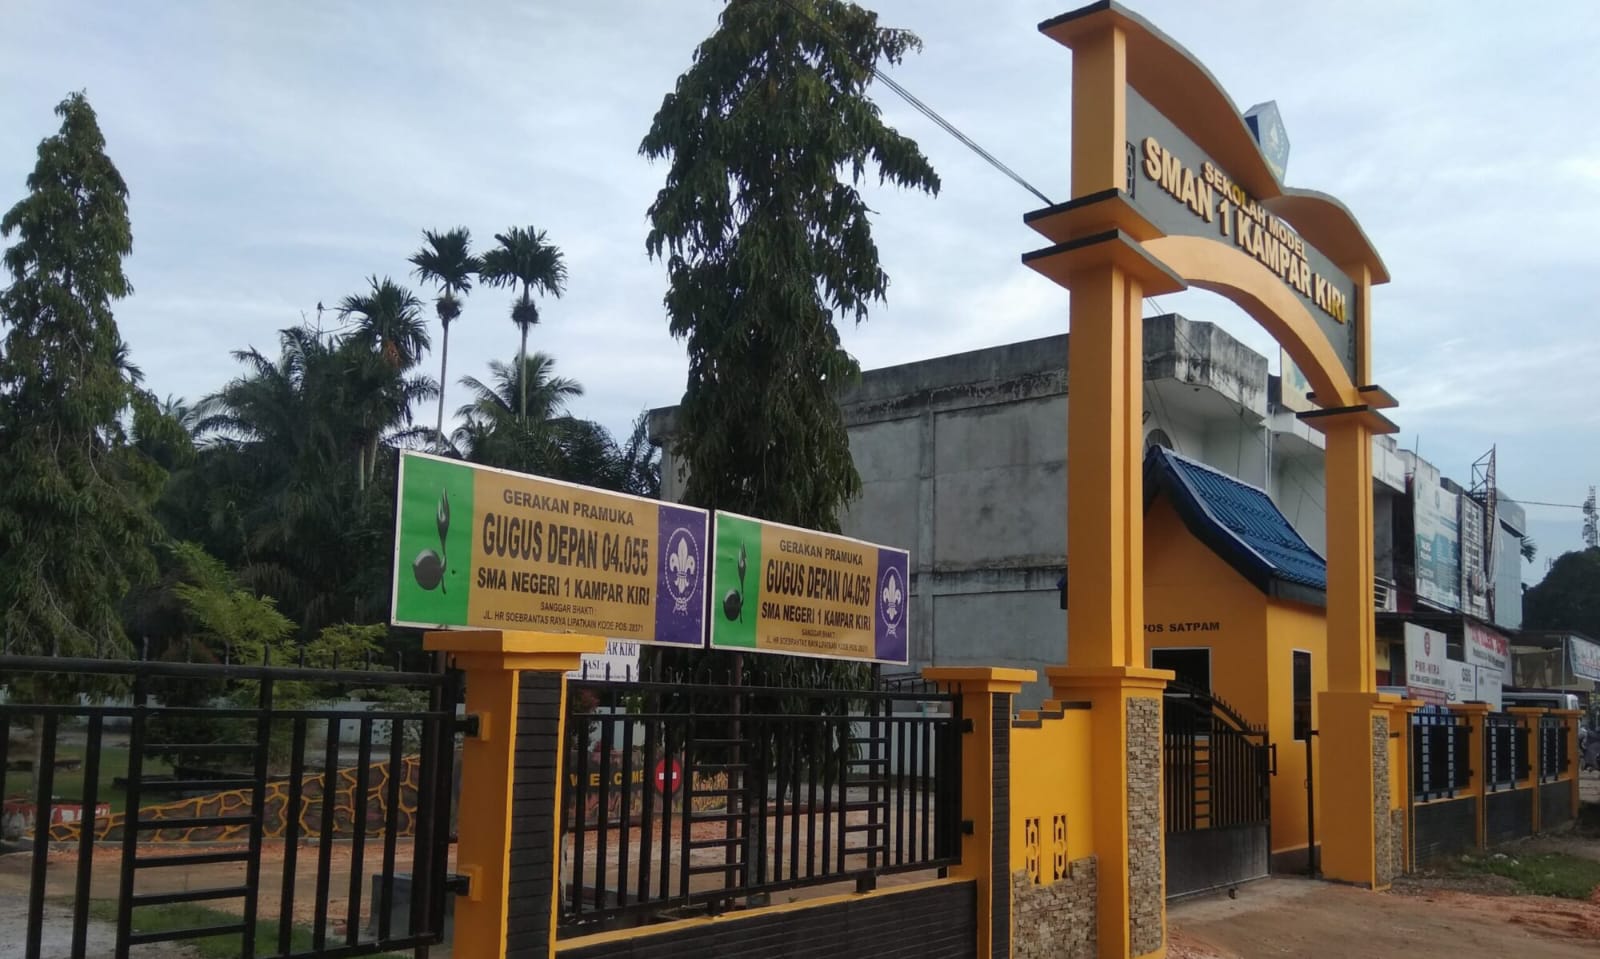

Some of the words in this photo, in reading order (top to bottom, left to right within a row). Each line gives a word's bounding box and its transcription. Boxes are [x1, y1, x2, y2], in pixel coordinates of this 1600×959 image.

[1202, 161, 1266, 228] SEKOLAH
[1267, 214, 1308, 263] MODEL
[1142, 136, 1213, 223] SMAN
[1217, 199, 1229, 236] 1
[1236, 208, 1312, 298] KAMPAR
[1313, 272, 1346, 324] KIRI
[503, 488, 569, 515] GERAKAN
[573, 502, 634, 526] PRAMUKA
[483, 512, 543, 562] GUGUS
[547, 523, 598, 570] DEPAN
[602, 532, 649, 577] 04.055
[780, 539, 822, 559] GERAKAN
[825, 548, 863, 566] PRAMUKA
[477, 566, 507, 591] SMA
[511, 571, 560, 596] NEGERI
[564, 577, 570, 598] 1
[574, 578, 624, 603] KAMPAR
[626, 585, 650, 606] KIRI
[766, 558, 805, 597] GUGUS
[807, 565, 841, 602] DEPAN
[842, 571, 871, 607] 04.056
[494, 612, 505, 622] HR
[505, 612, 549, 626] SOEBRANTAS
[549, 615, 566, 626] RAYA
[540, 601, 572, 614] SANGGAR
[572, 603, 594, 615] BHAKTI
[761, 601, 780, 620] SMA
[783, 604, 815, 624] NEGERI
[817, 608, 822, 625] 1
[824, 609, 854, 629] KAMPAR
[855, 614, 871, 631] KIRI
[1144, 623, 1164, 633] POS
[1169, 621, 1220, 633] SATPAM
[619, 641, 636, 657] KIRI
